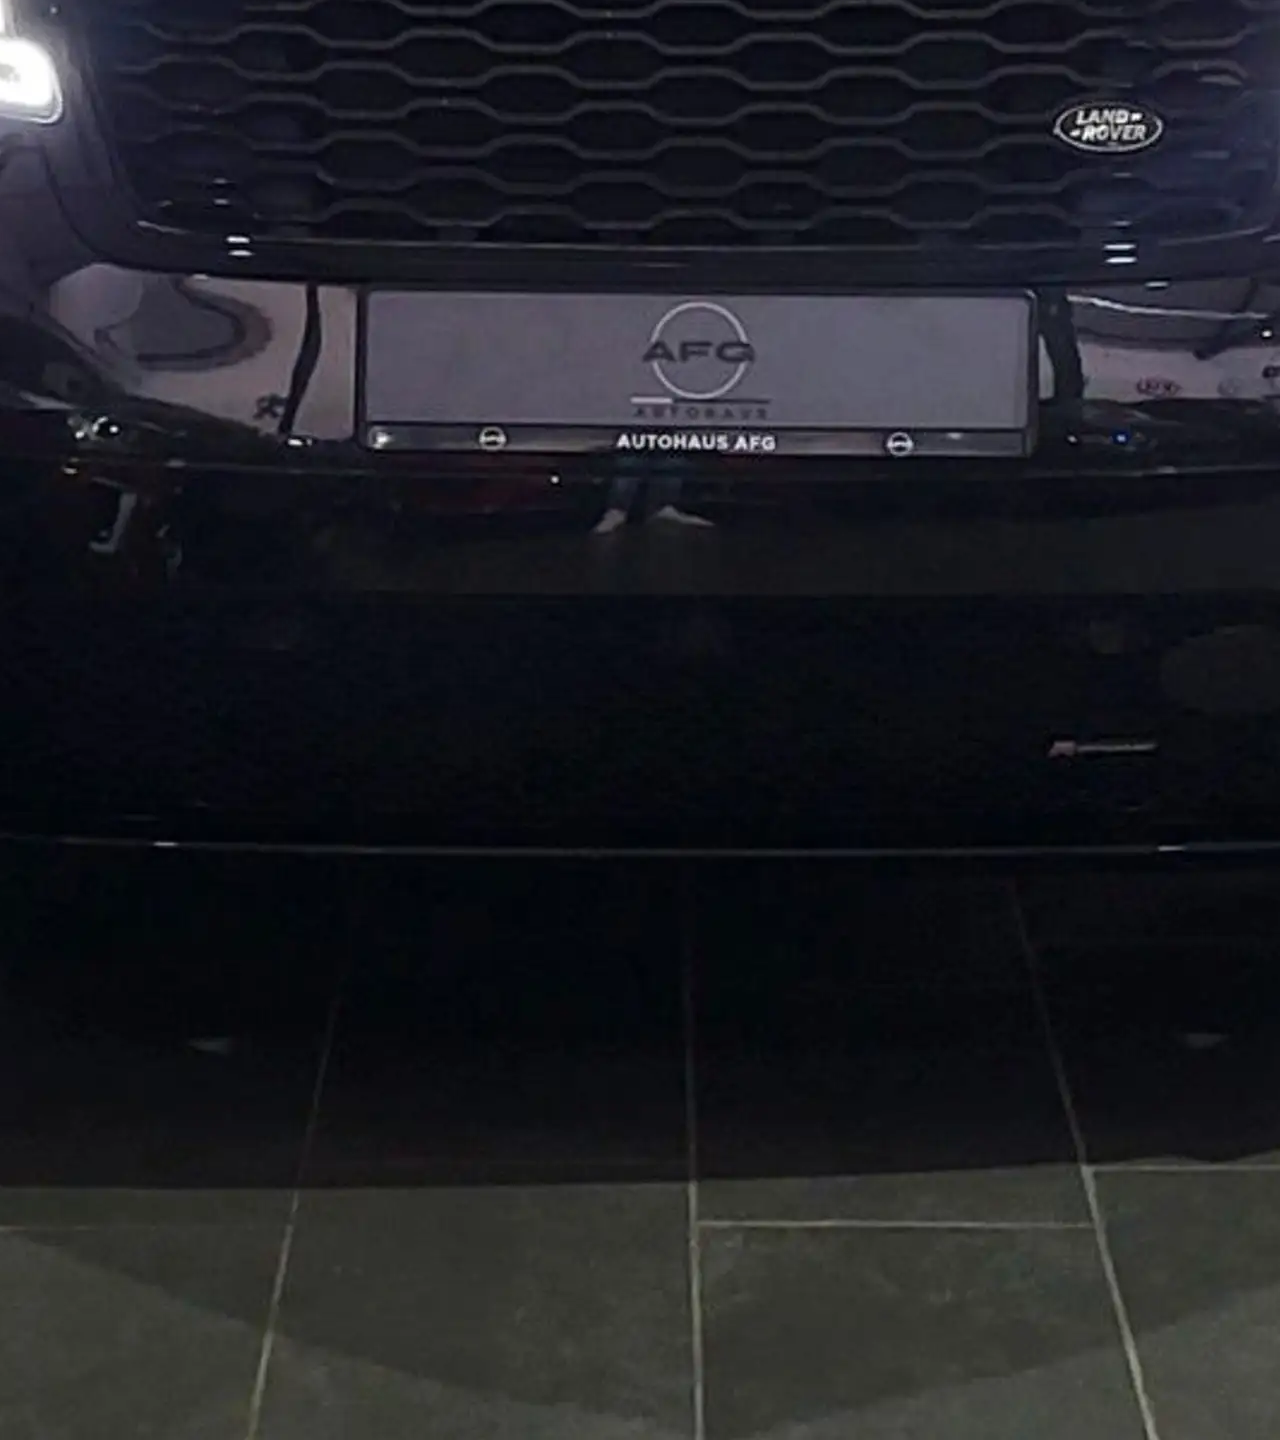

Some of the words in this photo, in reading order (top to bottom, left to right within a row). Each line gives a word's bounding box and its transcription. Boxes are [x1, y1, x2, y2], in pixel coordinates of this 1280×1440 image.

[642, 341, 756, 363] AFG
[616, 433, 729, 451] AUTOHAUS
[734, 436, 777, 451] AFG
